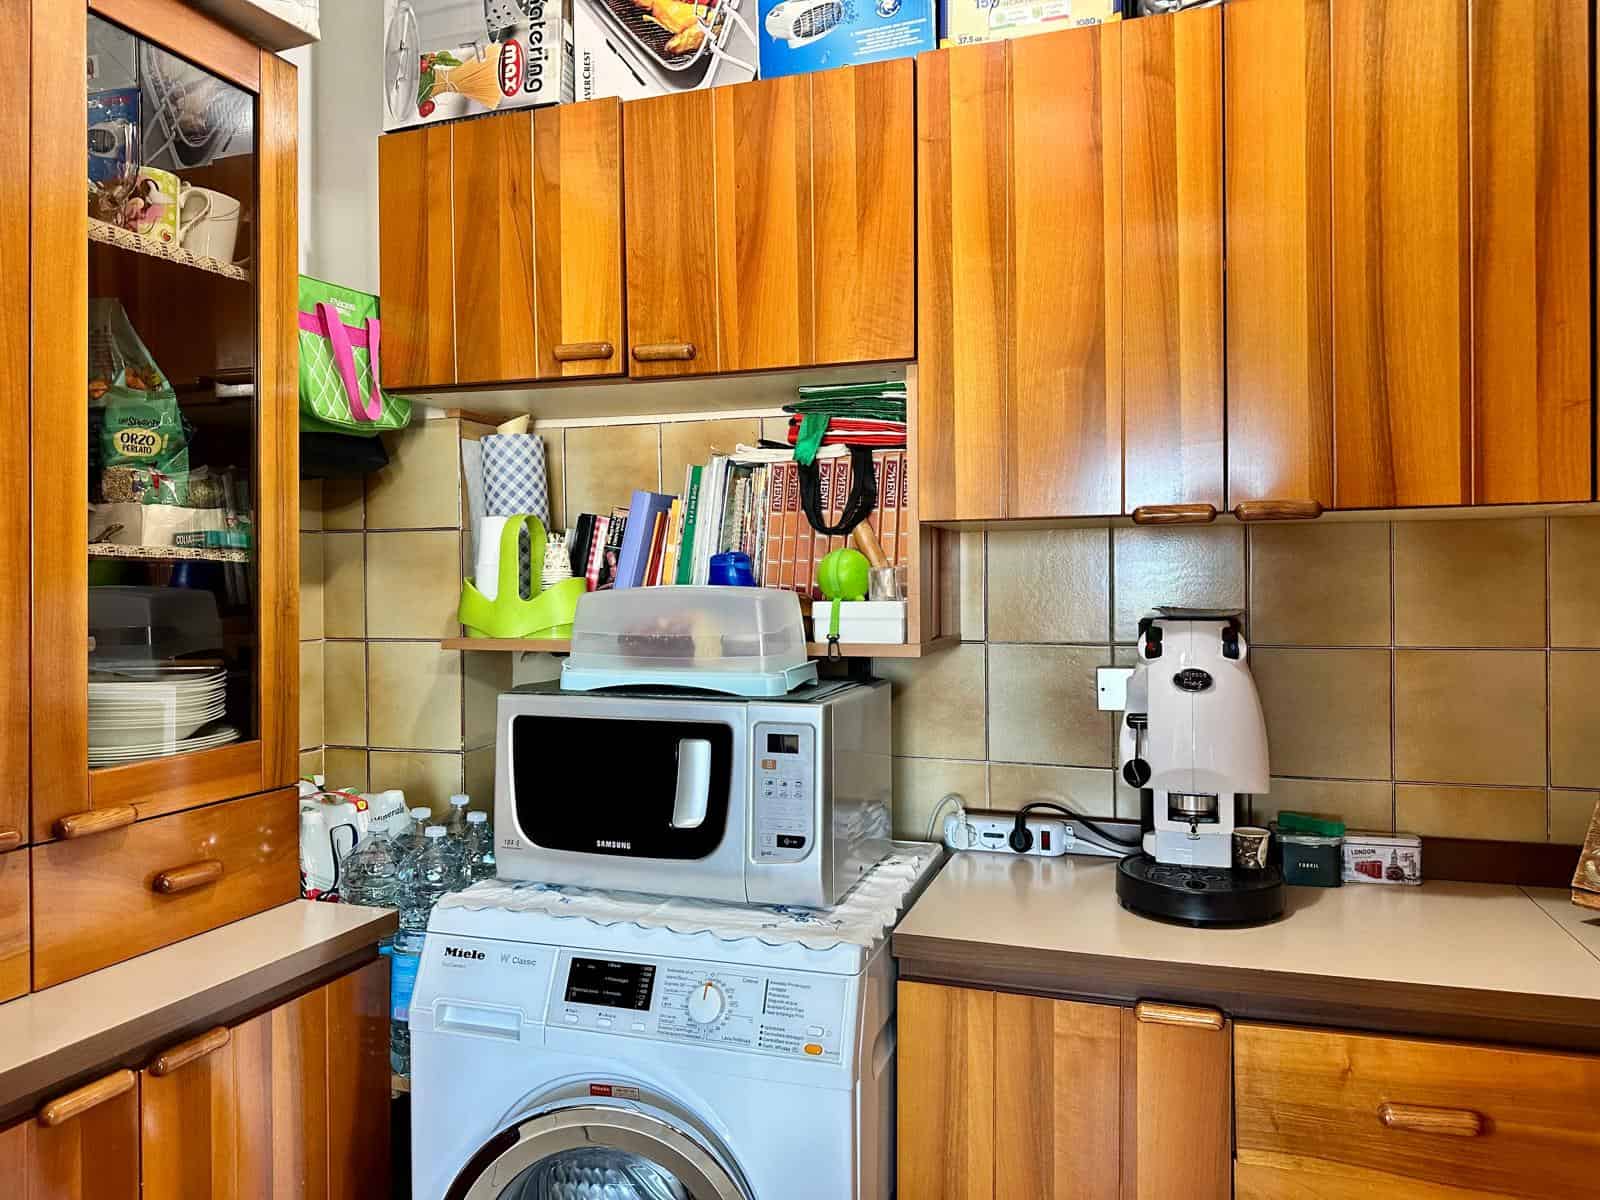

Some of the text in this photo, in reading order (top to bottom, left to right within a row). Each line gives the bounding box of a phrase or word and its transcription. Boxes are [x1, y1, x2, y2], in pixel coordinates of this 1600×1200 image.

[503, 44, 517, 92] max
[120, 432, 156, 446] ORZO
[596, 839, 631, 850] SAMSUNG
[1350, 847, 1377, 856] LONDON
[444, 946, 486, 960] Miele
[499, 952, 537, 966] W Classic
